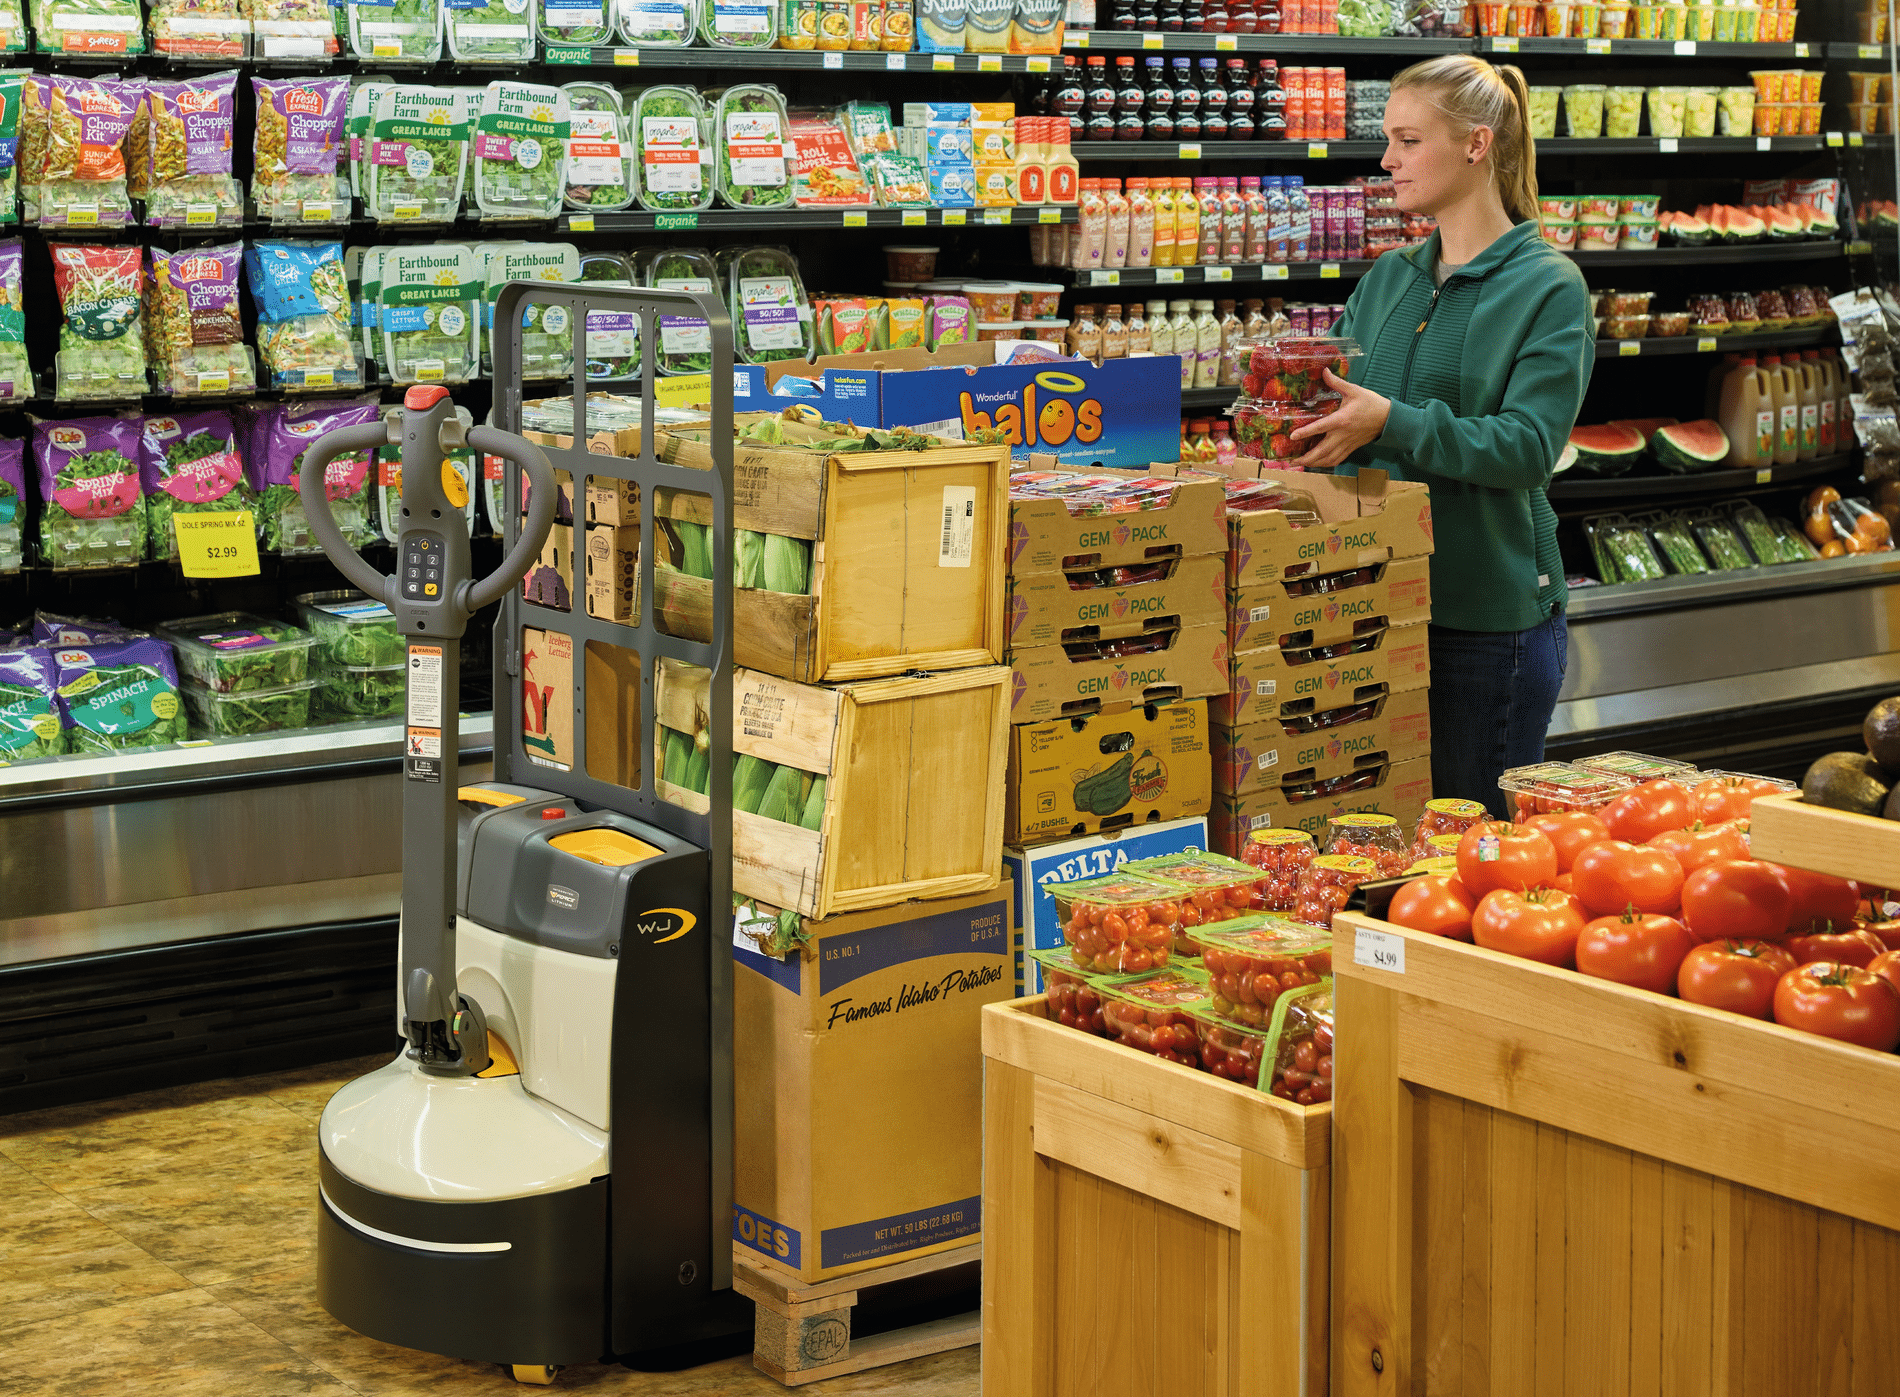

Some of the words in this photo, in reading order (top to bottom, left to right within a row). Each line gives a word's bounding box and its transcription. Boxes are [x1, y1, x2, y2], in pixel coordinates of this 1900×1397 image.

[88, 36, 120, 47] SHREDS
[546, 48, 590, 61] Organic
[290, 90, 318, 104] Fresh
[395, 92, 454, 107] Earthbound
[500, 87, 557, 104] Earthbound
[394, 105, 420, 118] Farm
[498, 102, 524, 114] Farm
[86, 116, 130, 134] Choppe
[188, 116, 232, 130] Chopped
[290, 115, 338, 131] Chopped
[496, 120, 524, 132] GREAT
[526, 122, 555, 134] LAKES
[86, 129, 104, 142] Kit
[189, 128, 207, 139] Kit
[290, 127, 308, 138] Kit
[392, 126, 422, 136] GREAT
[424, 126, 452, 137] LAKES
[380, 143, 402, 151] SWEET
[486, 137, 508, 146] SWEET
[486, 144, 498, 152] MIX
[192, 146, 215, 154] ASIAN
[291, 146, 316, 154] ASIAN
[804, 146, 828, 158] ROLL
[656, 215, 697, 229] Organic
[399, 254, 459, 269] Earthbound
[506, 252, 564, 268] Earthbound
[399, 269, 426, 282] Farm
[506, 268, 531, 280] Farm
[192, 294, 210, 307] Kit
[400, 290, 430, 300] GREAT
[432, 288, 460, 298] LAKES
[66, 302, 98, 316] BACON
[100, 296, 136, 308] CAESAR
[936, 306, 968, 317] WHOLLY
[392, 309, 415, 317] CRISPY
[443, 315, 461, 323] PURE
[591, 315, 618, 324] 50/50!
[759, 308, 785, 318] 50/50!
[836, 308, 867, 319] WHOLLY
[892, 308, 923, 318] WHOLLY
[392, 316, 420, 324] LETTUCE
[976, 390, 1018, 402] Wonderful
[960, 382, 1103, 446] halos
[150, 420, 176, 434] Dole
[292, 421, 318, 434] Dole
[54, 430, 82, 445] Dole
[180, 452, 226, 478] SPRING
[195, 466, 217, 481] MIX
[325, 470, 346, 482] MIX
[75, 473, 125, 496] SPRING
[92, 486, 114, 499] MIX
[200, 520, 224, 528] SPRING
[1079, 531, 1110, 548] GEM
[1132, 525, 1168, 542] PACK
[1298, 542, 1325, 559] GEM
[1344, 531, 1377, 550] PACK
[207, 546, 238, 558] $2.99
[430, 556, 436, 564] 2
[412, 570, 416, 578] 3
[1078, 604, 1108, 620] GEM
[1130, 596, 1166, 614] PACK
[1294, 608, 1322, 626] GEM
[1342, 600, 1374, 617] PACK
[64, 635, 87, 644] Dole
[548, 634, 572, 651] Iceberg
[62, 652, 88, 662] Dole
[548, 645, 572, 660] Lettuce
[1078, 677, 1108, 694] GEM
[1130, 668, 1166, 686] PACK
[1294, 676, 1322, 694] GEM
[1342, 666, 1374, 684] PACK
[89, 680, 148, 710] SPINACH
[1298, 746, 1324, 765] GEM
[1344, 735, 1376, 754] PACK
[1132, 762, 1162, 786] Fresh
[1182, 798, 1202, 808] SQUASH
[1026, 822, 1040, 832] 4/7
[1040, 816, 1070, 829] BUSHEL
[1300, 814, 1328, 832] GEM
[552, 898, 572, 907] LITHIUM
[637, 918, 671, 935] WJ
[971, 914, 1001, 930] PRODUCE
[971, 931, 980, 942] OF
[981, 928, 1002, 940] U.S.A.
[826, 950, 840, 961] U.S.
[842, 946, 854, 958] NO.
[856, 944, 860, 956] 1
[1374, 949, 1397, 967] $4.99
[828, 997, 892, 1030] Famous
[942, 964, 1003, 1000] Potatoes
[875, 1228, 889, 1240] NET
[890, 1226, 902, 1237] WT.
[904, 1222, 914, 1234] 50
[914, 1220, 928, 1232] LBS
[929, 1214, 950, 1230] (22.68
[952, 1210, 964, 1222] KG)
[842, 1250, 862, 1260] Packed
[881, 1240, 910, 1252] Distributed
[910, 1238, 918, 1246] by:
